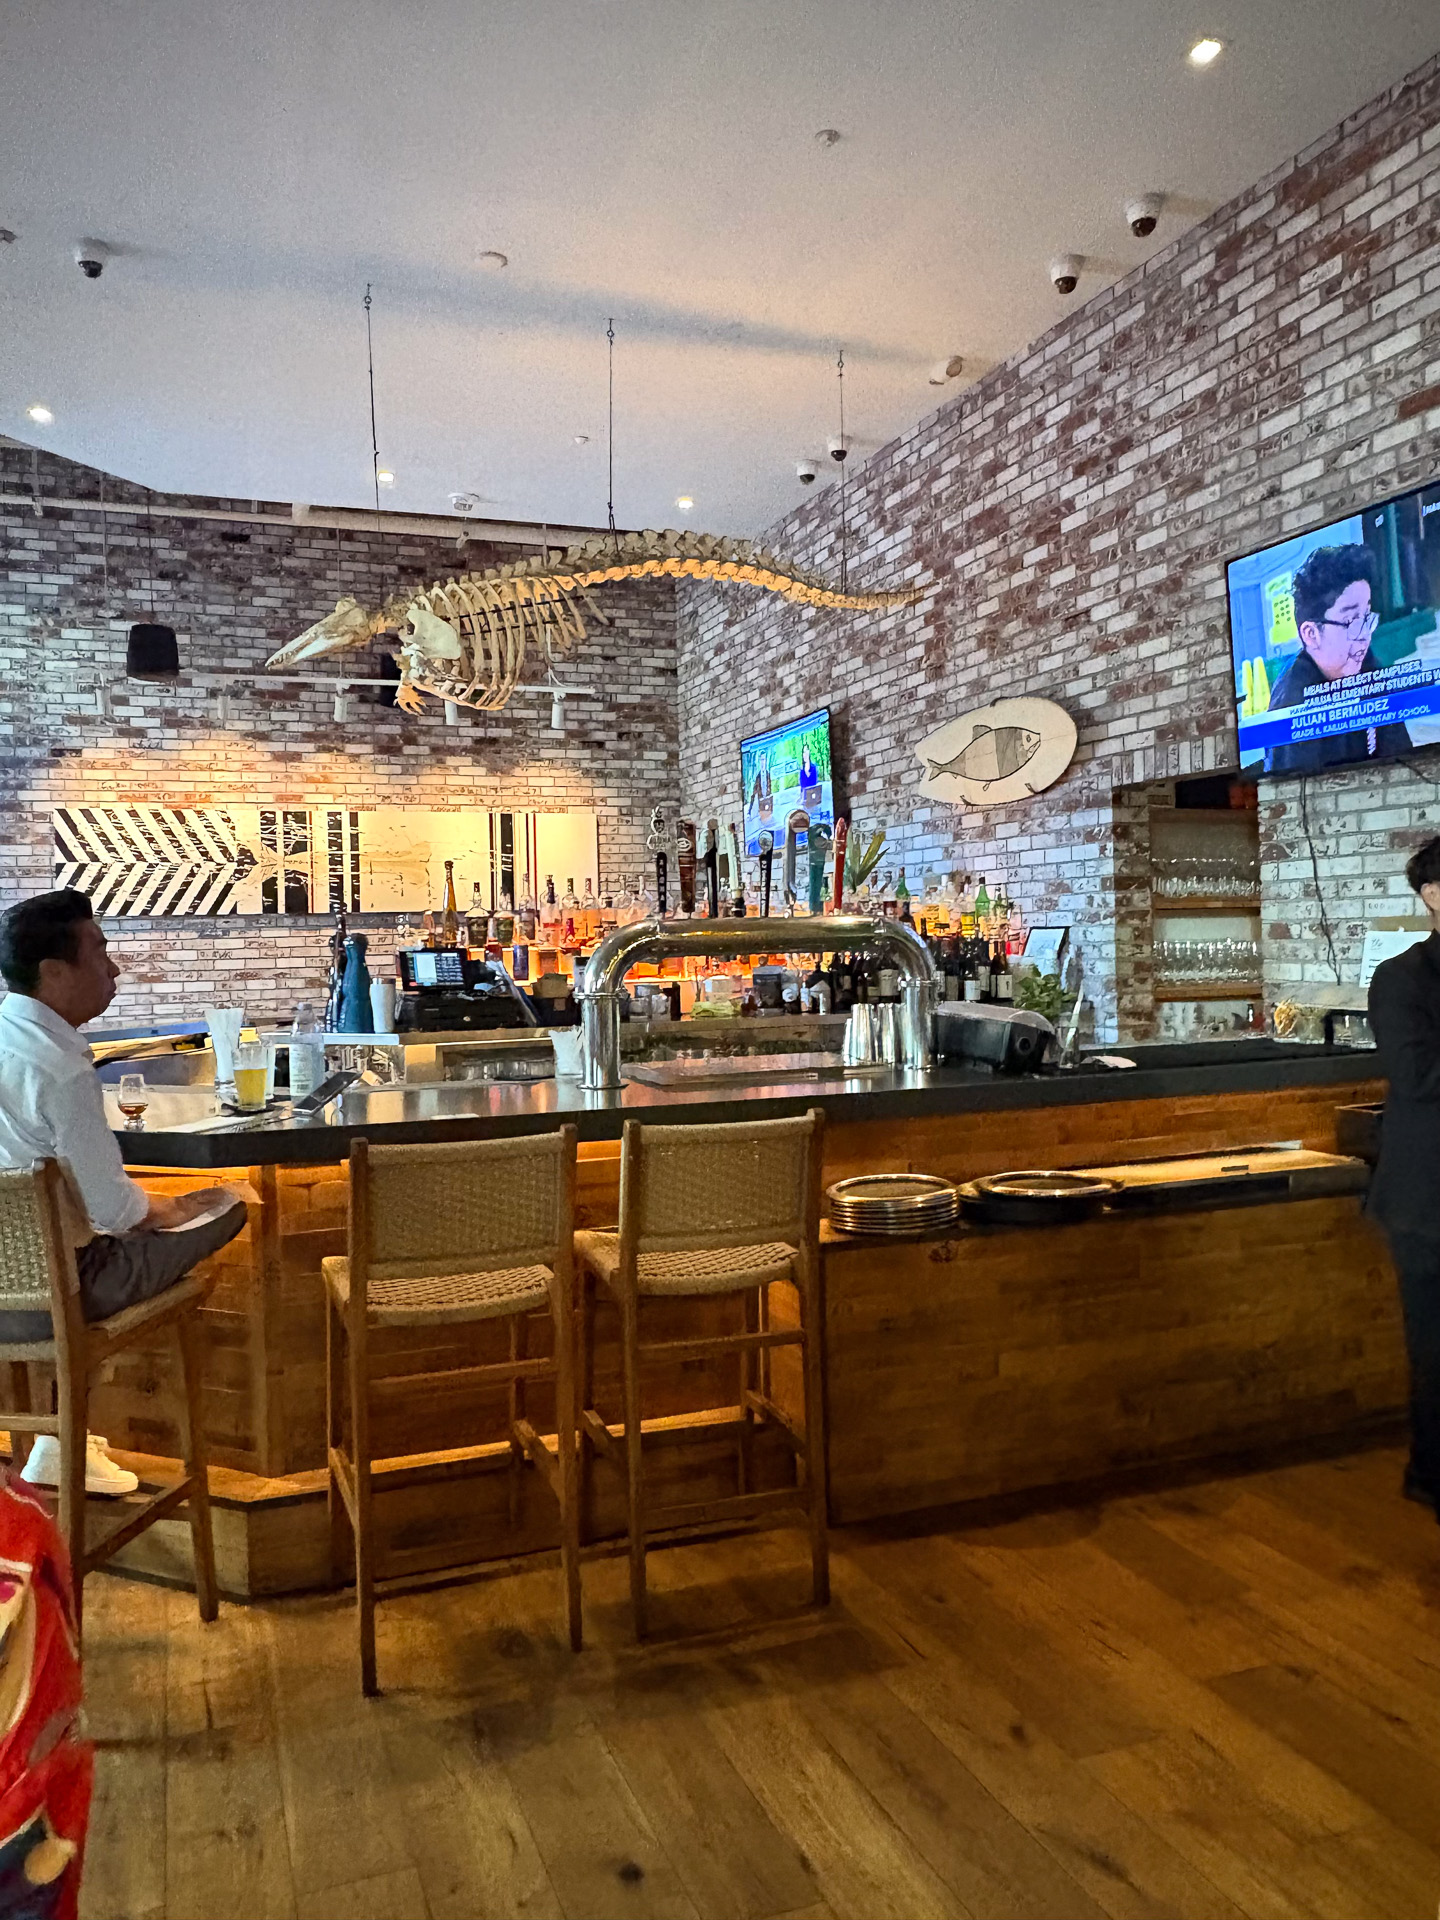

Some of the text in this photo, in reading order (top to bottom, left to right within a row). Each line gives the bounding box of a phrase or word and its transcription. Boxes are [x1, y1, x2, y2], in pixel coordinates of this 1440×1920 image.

[1331, 679, 1342, 691] AT
[1291, 712, 1327, 730] JULIAN
[1328, 698, 1390, 722] BERMUDEZ
[1397, 704, 1431, 719] SCHOOL
